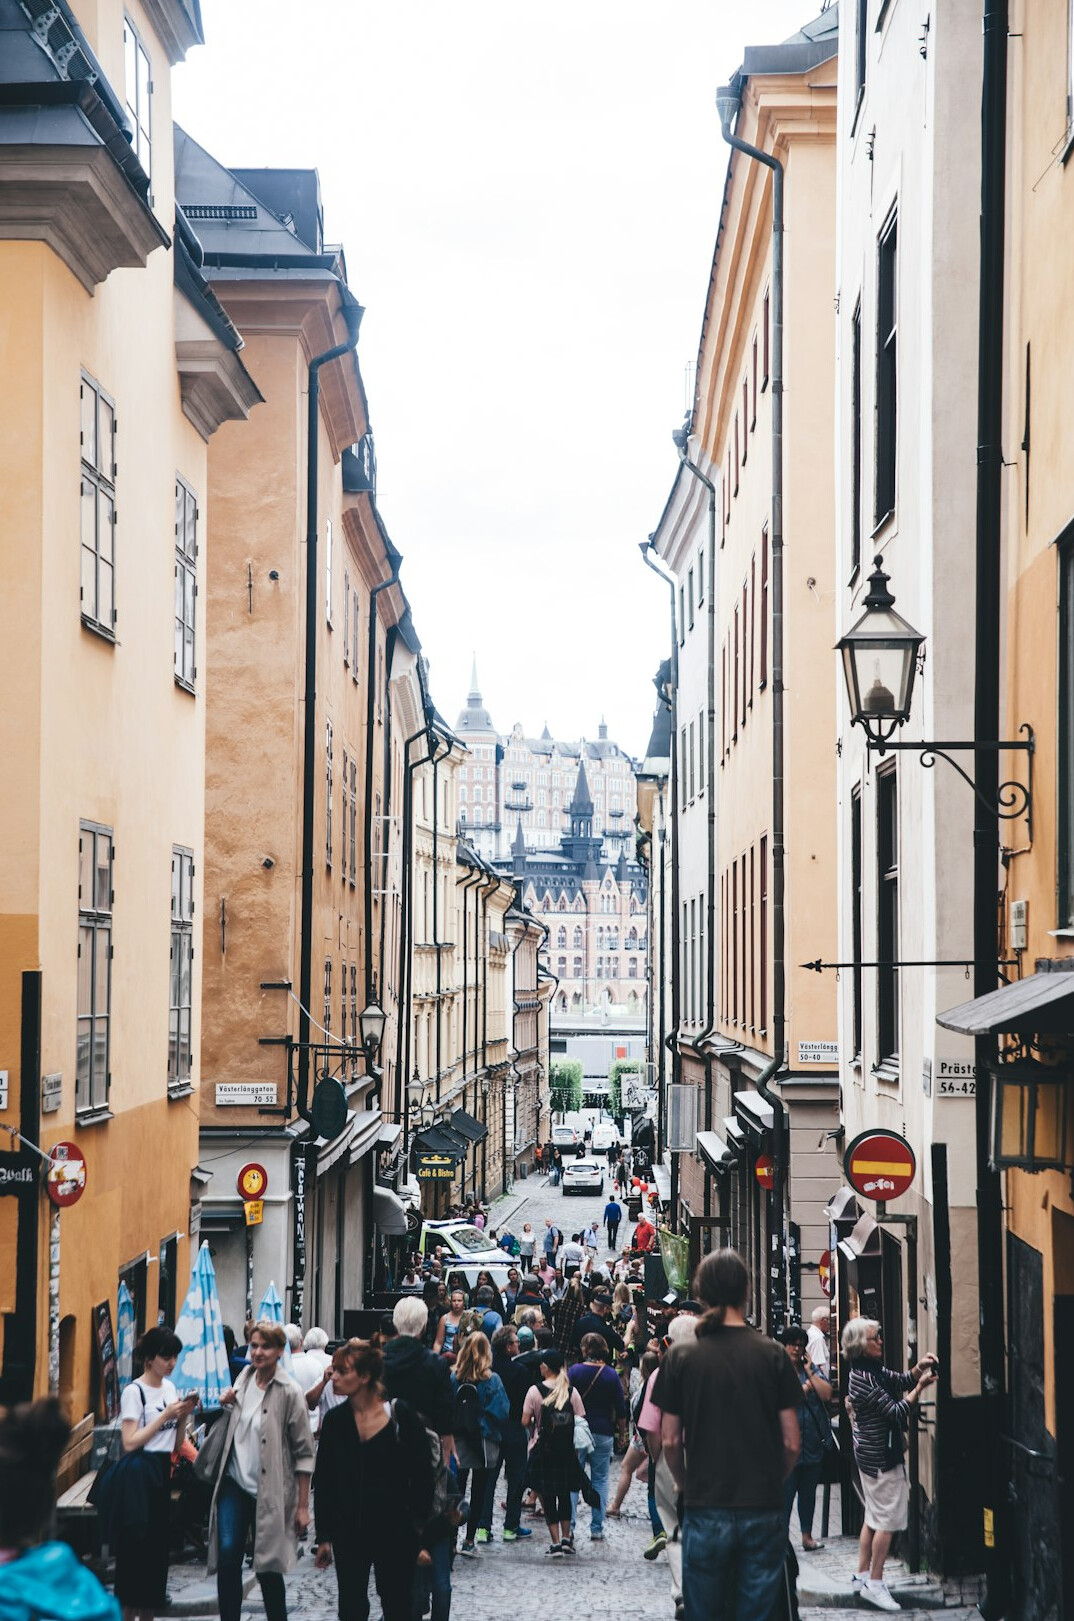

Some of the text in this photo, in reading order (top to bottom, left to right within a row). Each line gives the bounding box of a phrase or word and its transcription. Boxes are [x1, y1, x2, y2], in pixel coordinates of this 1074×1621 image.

[219, 1085, 274, 1093] Västerlånggatan
[941, 1082, 975, 1094] 56-42
[432, 1168, 437, 1177] &
[438, 1168, 454, 1177] Bistro
